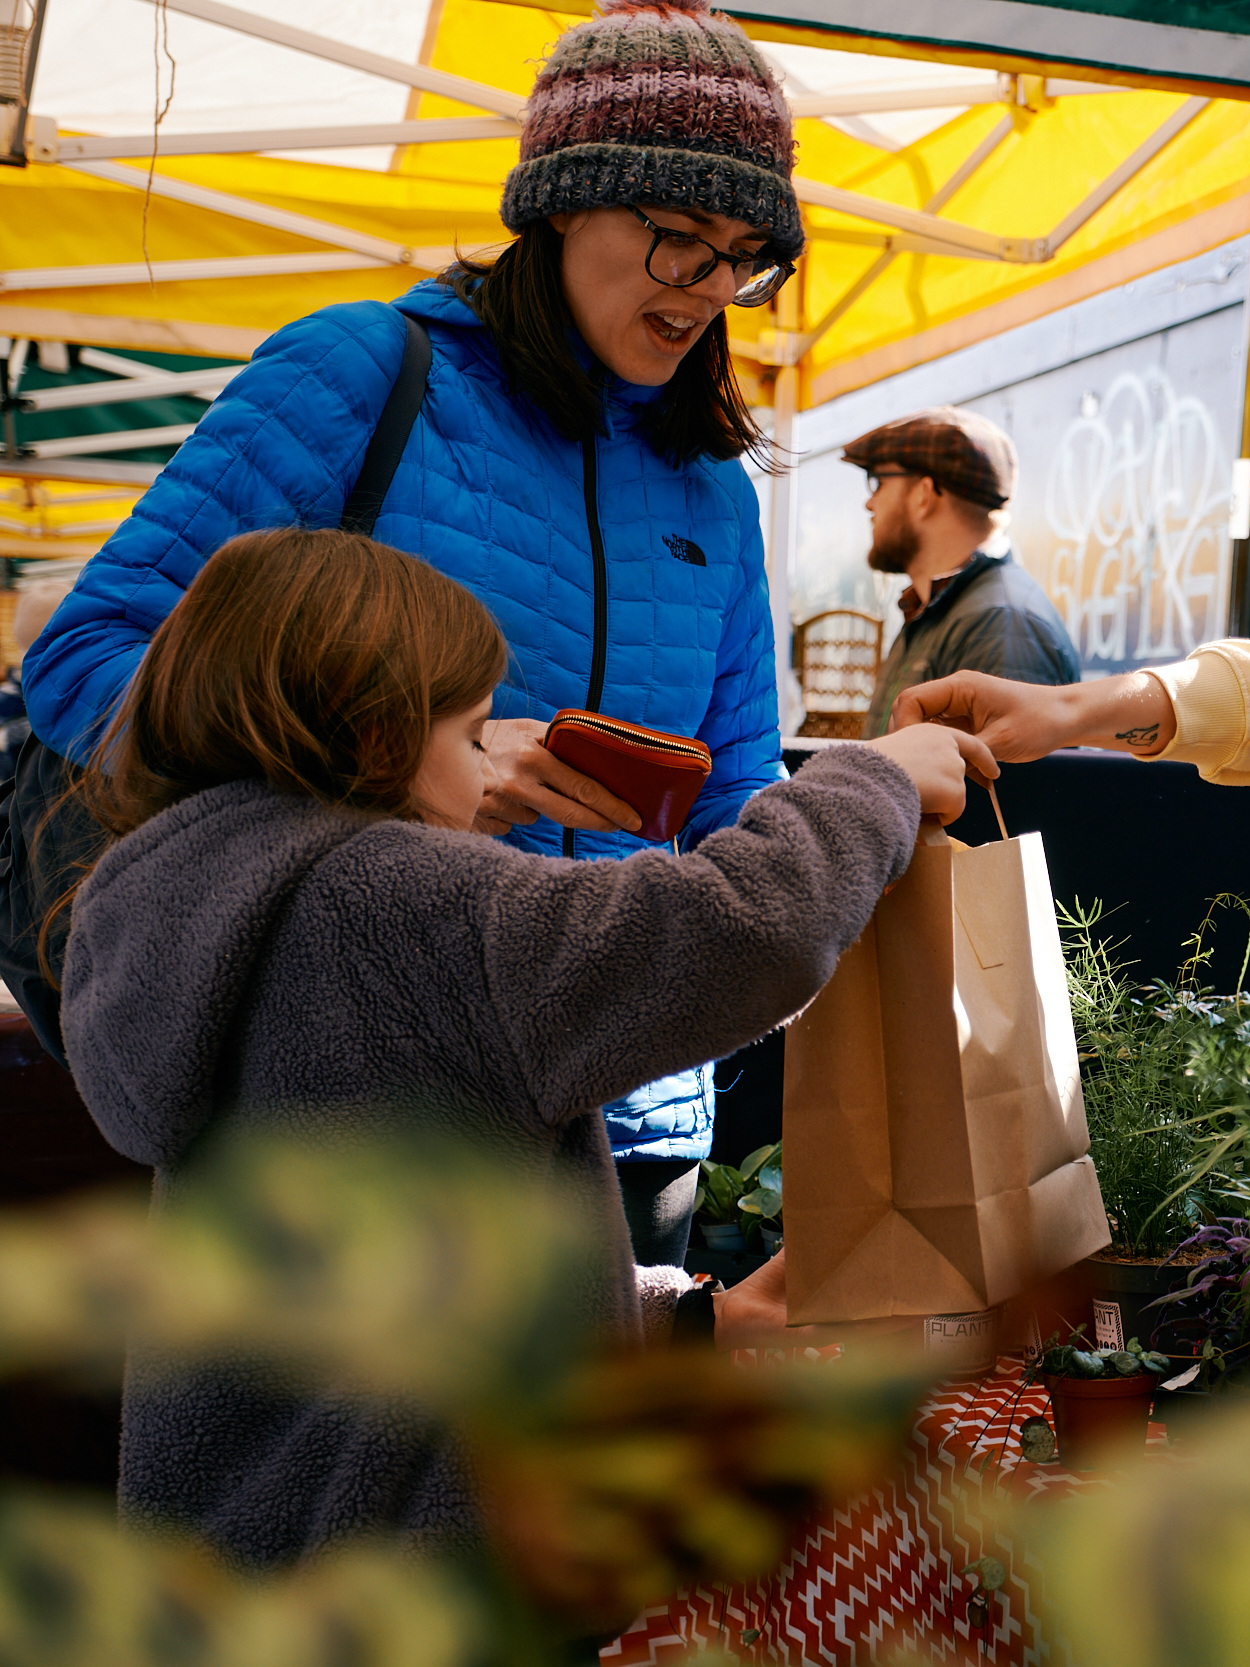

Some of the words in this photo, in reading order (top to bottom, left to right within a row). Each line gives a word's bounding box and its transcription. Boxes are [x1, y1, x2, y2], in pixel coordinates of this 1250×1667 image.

[661, 535, 688, 557] NORTH
[672, 533, 687, 548] THE
[670, 548, 690, 564] FACE
[931, 1320, 991, 1337] PLANT
